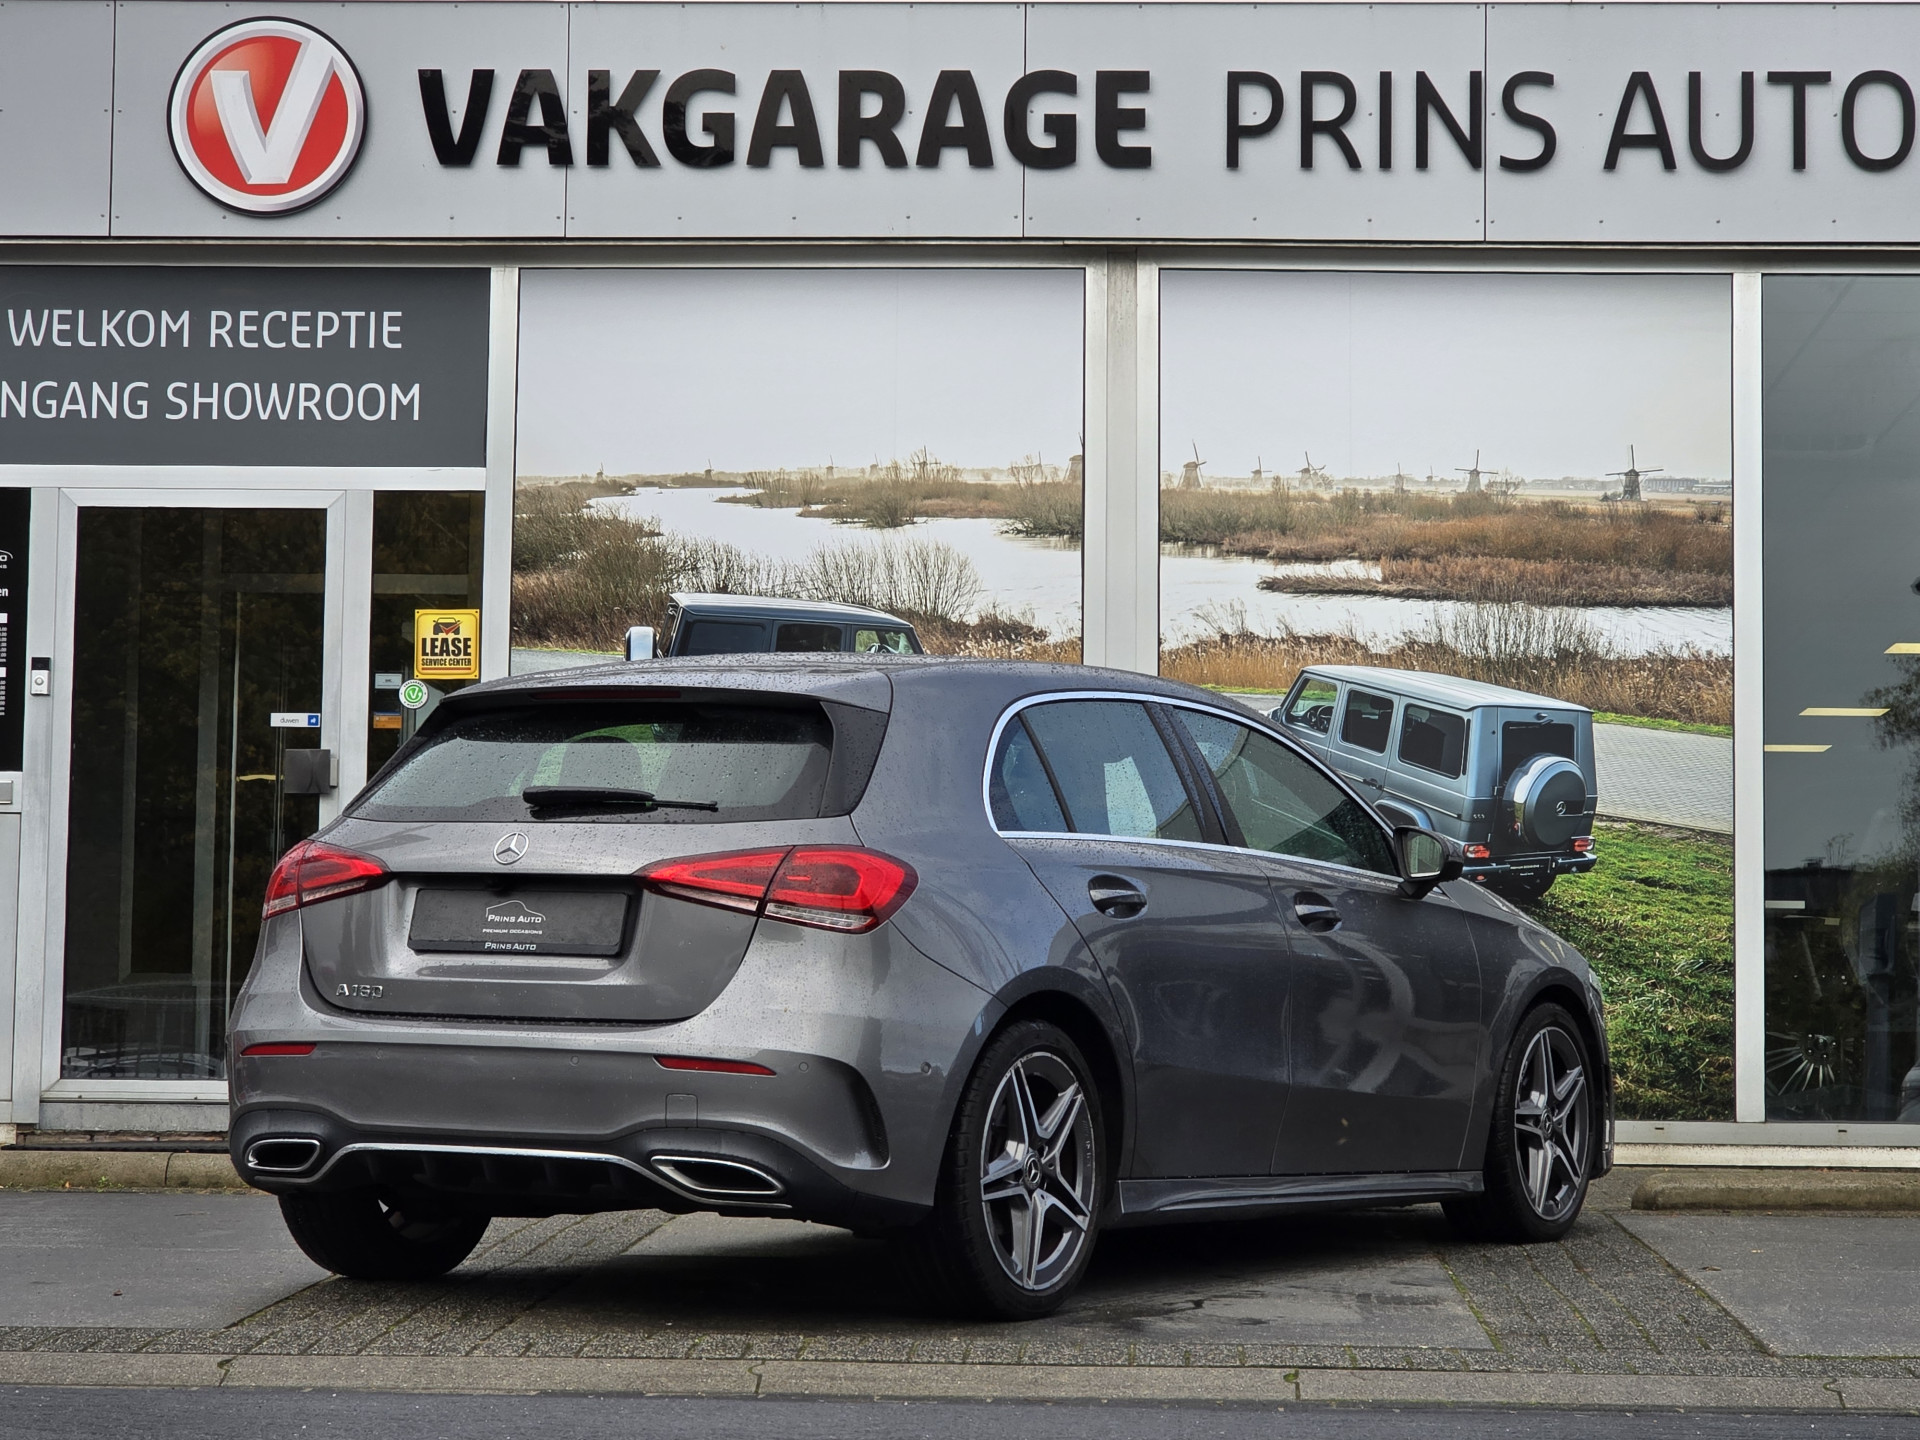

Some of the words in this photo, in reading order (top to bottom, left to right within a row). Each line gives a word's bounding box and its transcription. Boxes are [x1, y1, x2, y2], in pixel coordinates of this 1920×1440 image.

[417, 68, 1152, 170] VAKGARAGE
[1226, 70, 1557, 172] PRINS
[1603, 70, 1916, 173] AUTO
[7, 309, 190, 348] WELKOM
[209, 310, 403, 349] RECEPTIE
[0, 380, 149, 420] NGANG
[165, 382, 420, 421] SHOWROOM
[421, 637, 472, 657] LEASE
[421, 658, 447, 666] SERVICE
[448, 658, 472, 666] CENTER
[487, 914, 516, 923] PRINS
[517, 915, 542, 923] AUTO
[484, 942, 512, 950] PRINS
[512, 942, 537, 951] AUTO
